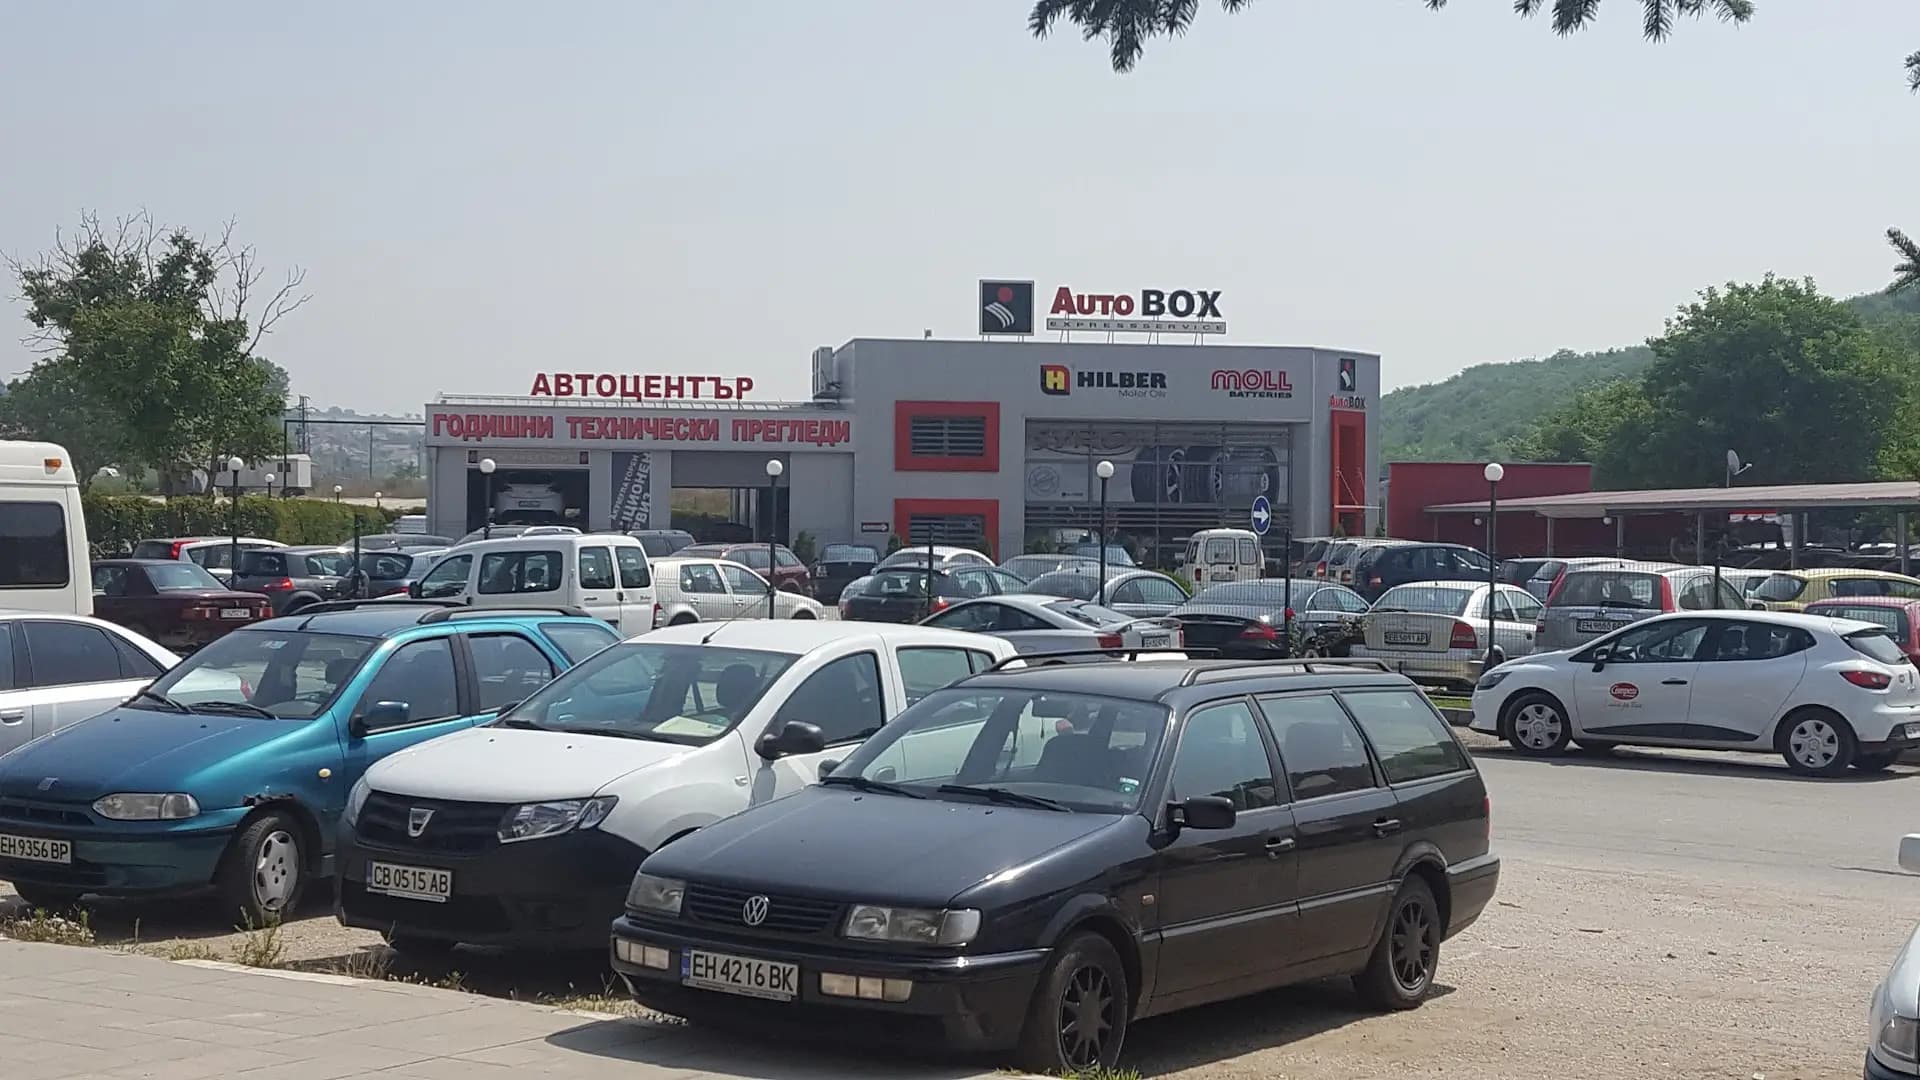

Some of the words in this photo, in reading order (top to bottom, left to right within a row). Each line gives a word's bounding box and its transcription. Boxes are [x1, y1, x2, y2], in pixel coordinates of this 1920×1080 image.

[1141, 288, 1223, 318] BOX
[530, 373, 754, 402] АВТОЦЕНТЪР
[1077, 371, 1167, 389] HILBER
[1229, 390, 1293, 399] BATTERIES
[433, 414, 554, 441] ГОДИШНИ
[565, 416, 720, 442] ТЕХНИЧЕСКИ
[731, 418, 850, 447] ПРЕГЛЕДИ
[1, 836, 17, 855] EH
[18, 839, 49, 858] 9356
[50, 842, 69, 860] BP
[374, 865, 391, 886] CB
[393, 868, 426, 890] 0515
[430, 873, 449, 893] AB
[693, 953, 718, 979] EH
[720, 958, 766, 987] 4216
[769, 965, 795, 992] BK
